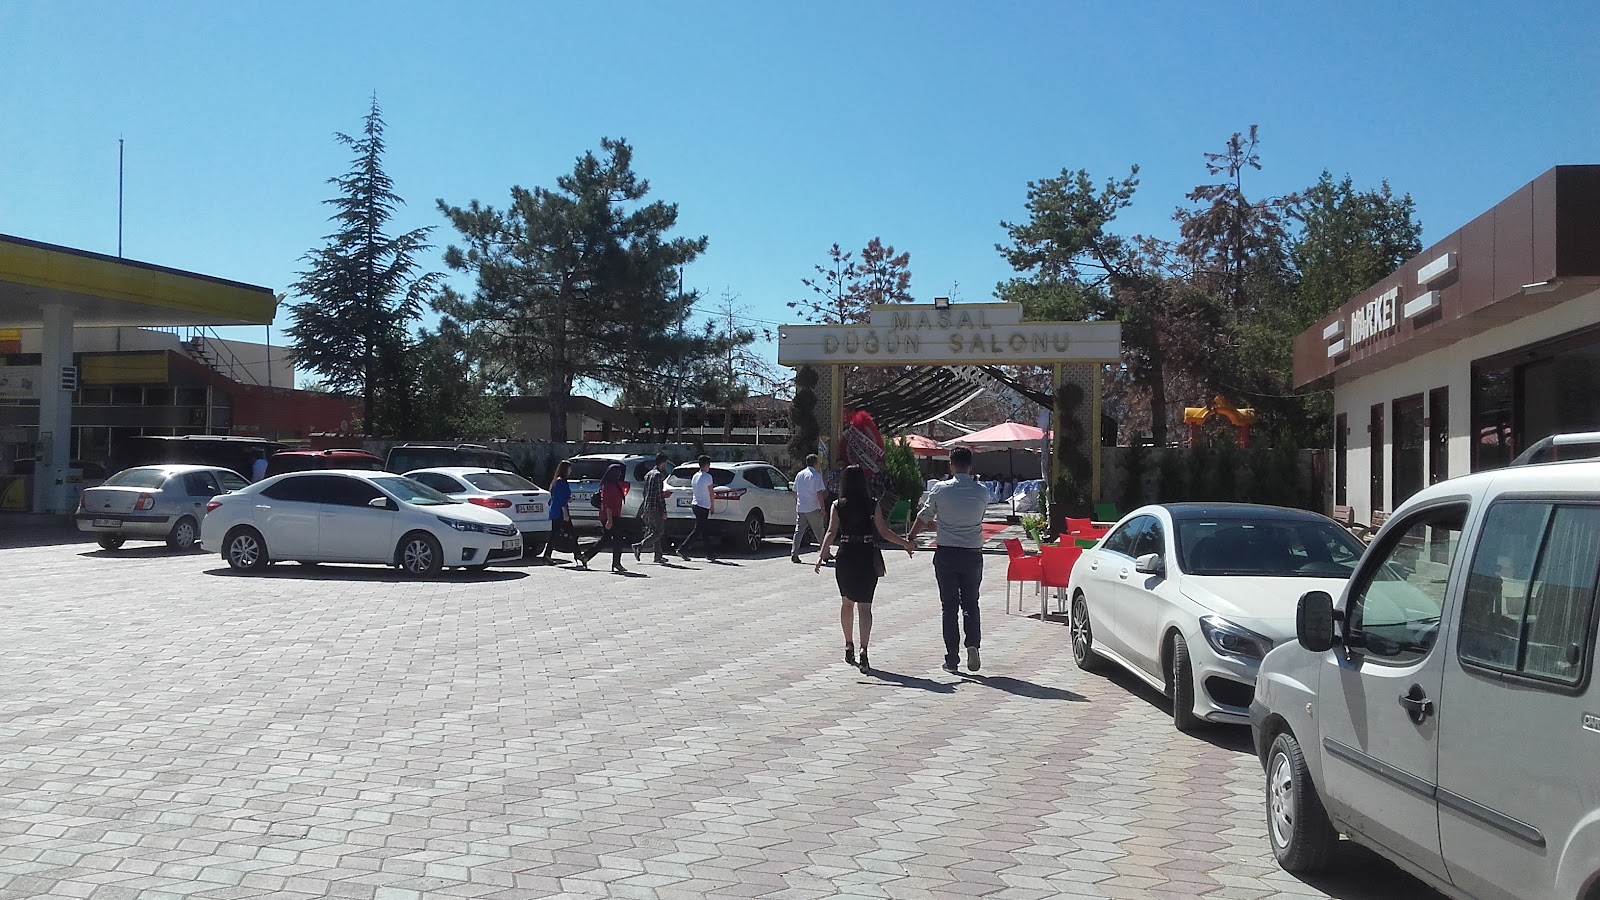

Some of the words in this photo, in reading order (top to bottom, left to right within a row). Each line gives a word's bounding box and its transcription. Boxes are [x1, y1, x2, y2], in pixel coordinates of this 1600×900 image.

[891, 310, 992, 331] MASAL
[1350, 286, 1398, 346] MARKET
[823, 330, 920, 355] DÜĞÜN
[949, 332, 1071, 355] SALONU
